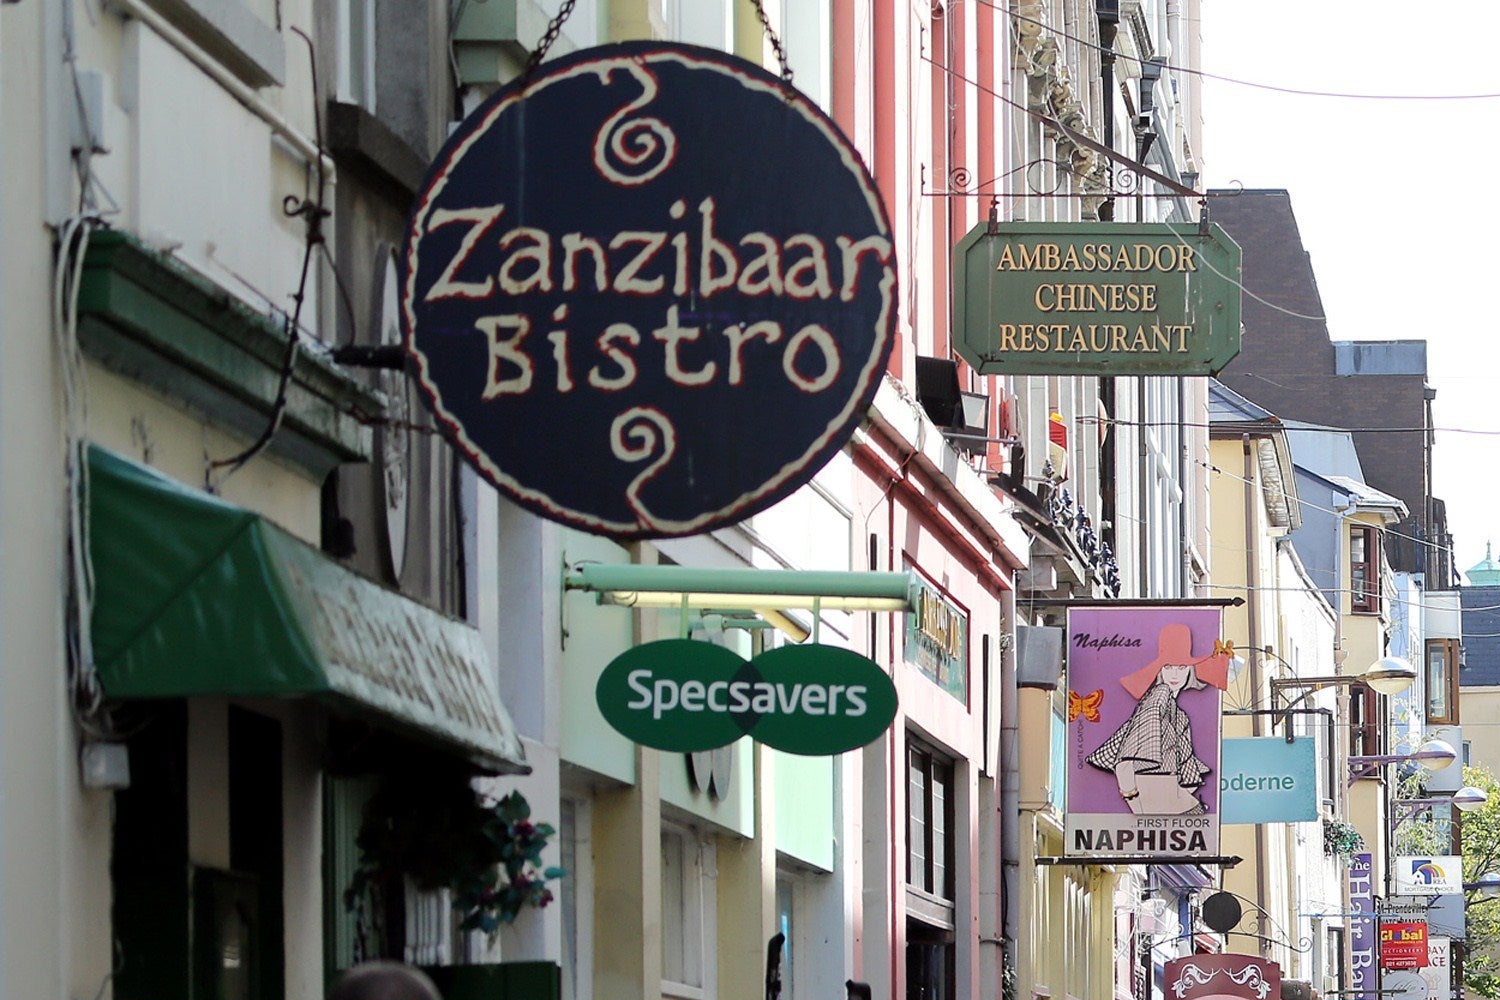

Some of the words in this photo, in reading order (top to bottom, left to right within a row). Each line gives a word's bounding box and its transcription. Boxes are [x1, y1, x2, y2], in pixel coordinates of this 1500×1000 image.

[425, 197, 892, 300] Zanzibaar
[997, 243, 1197, 273] AMBASSADOR
[1034, 283, 1157, 313] CHINESE
[476, 304, 841, 399] Bistro
[999, 323, 1193, 353] RESTAURANT
[1072, 633, 1142, 651] Naphisa
[626, 669, 868, 720] Specsavers
[1220, 773, 1295, 792] oderne
[1171, 817, 1211, 828] FLOOR
[1074, 828, 1208, 851] NAPHISA
